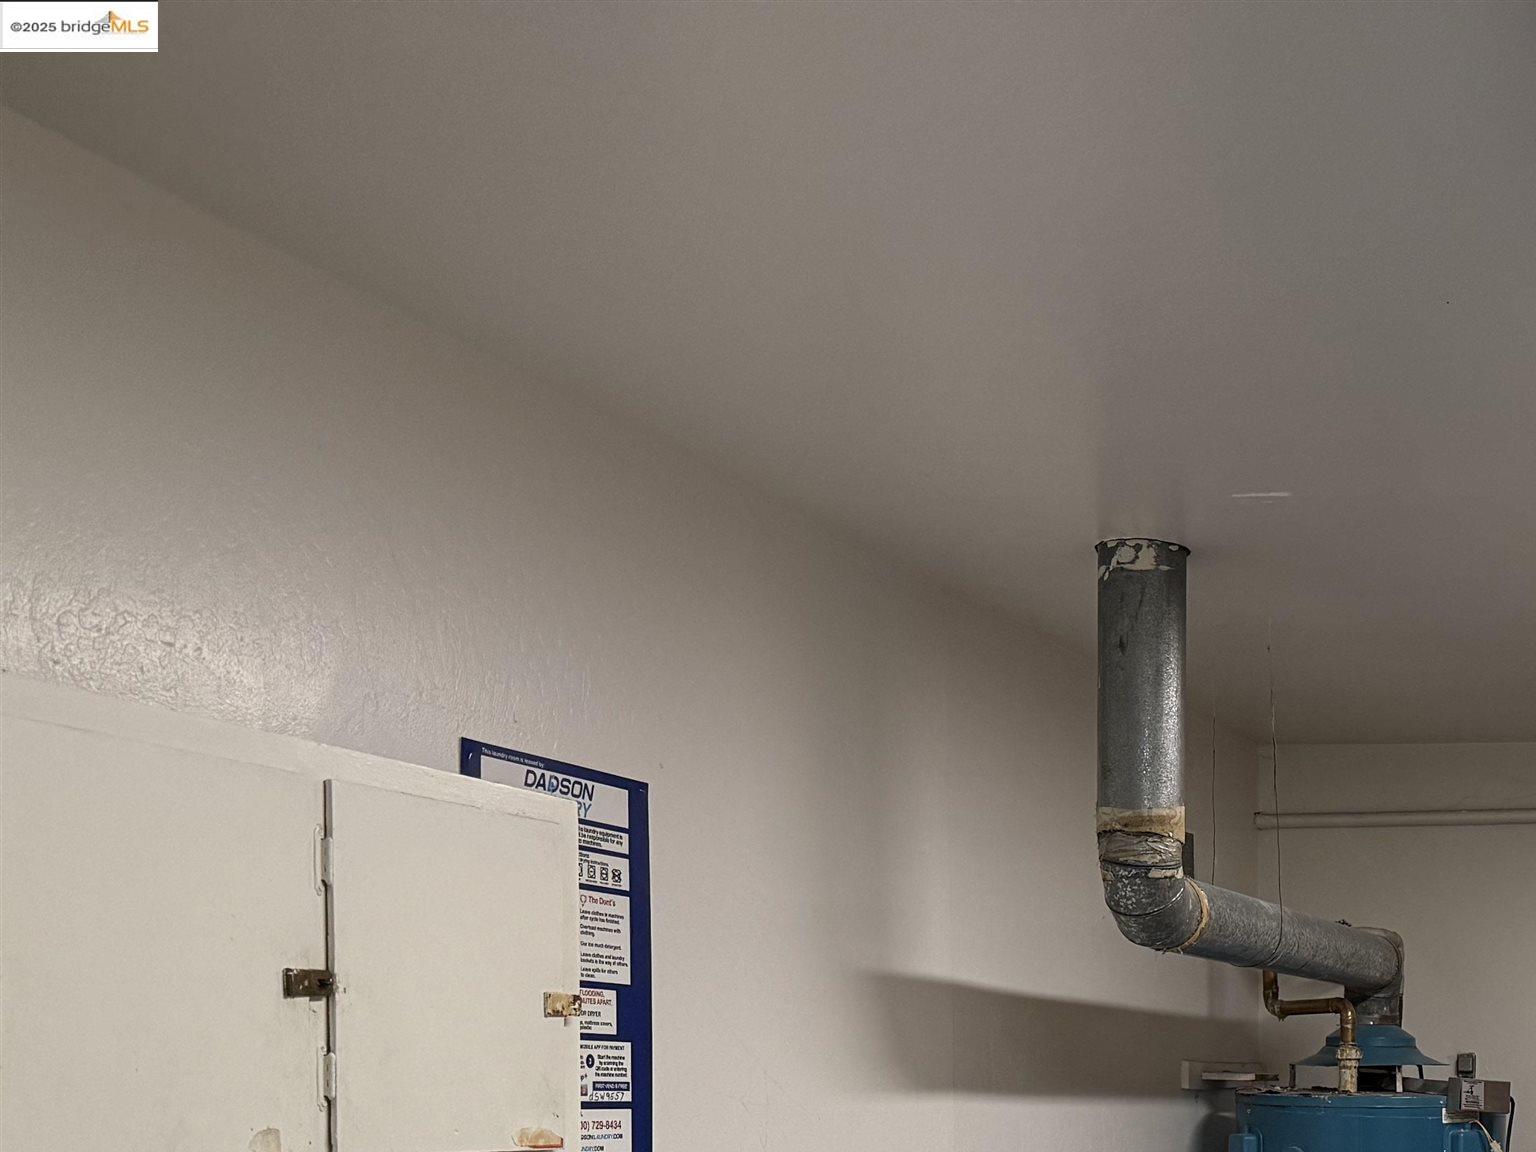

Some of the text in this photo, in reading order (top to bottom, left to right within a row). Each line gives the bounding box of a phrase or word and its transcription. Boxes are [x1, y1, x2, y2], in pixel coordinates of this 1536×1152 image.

[524, 769, 594, 801] DADSON
[589, 896, 598, 904] The
[592, 1121, 622, 1130] 729-8434
